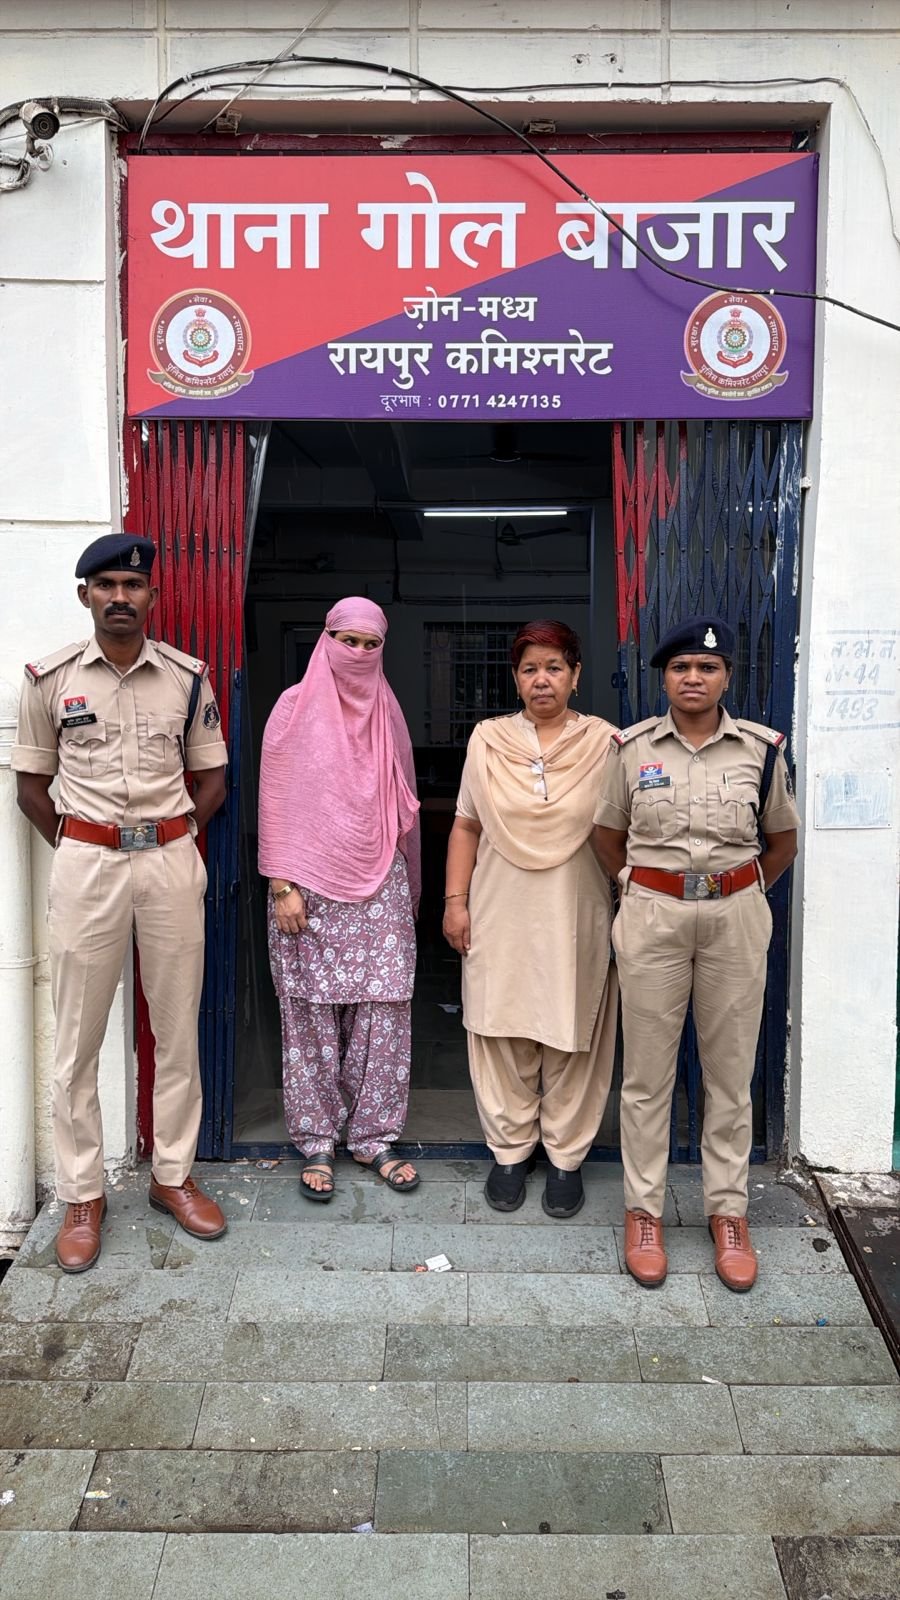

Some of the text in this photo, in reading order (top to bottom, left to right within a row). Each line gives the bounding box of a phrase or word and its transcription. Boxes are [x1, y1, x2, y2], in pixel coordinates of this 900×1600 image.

[150, 171, 795, 272] थाना गोल बाजार
[192, 295, 208, 303] सेवा
[403, 286, 538, 330] ज़ोन-मध्य
[728, 295, 743, 303] सेवा
[327, 328, 614, 390] रायपुर कमिश्नरेट
[167, 363, 184, 380] पुलिस
[217, 364, 235, 380] रायपुर
[700, 364, 717, 382] पुलिस
[752, 365, 770, 381] रायपुर
[379, 394, 421, 412] दूरभाष
[438, 394, 480, 408] 0771
[486, 394, 562, 408] 4247135
